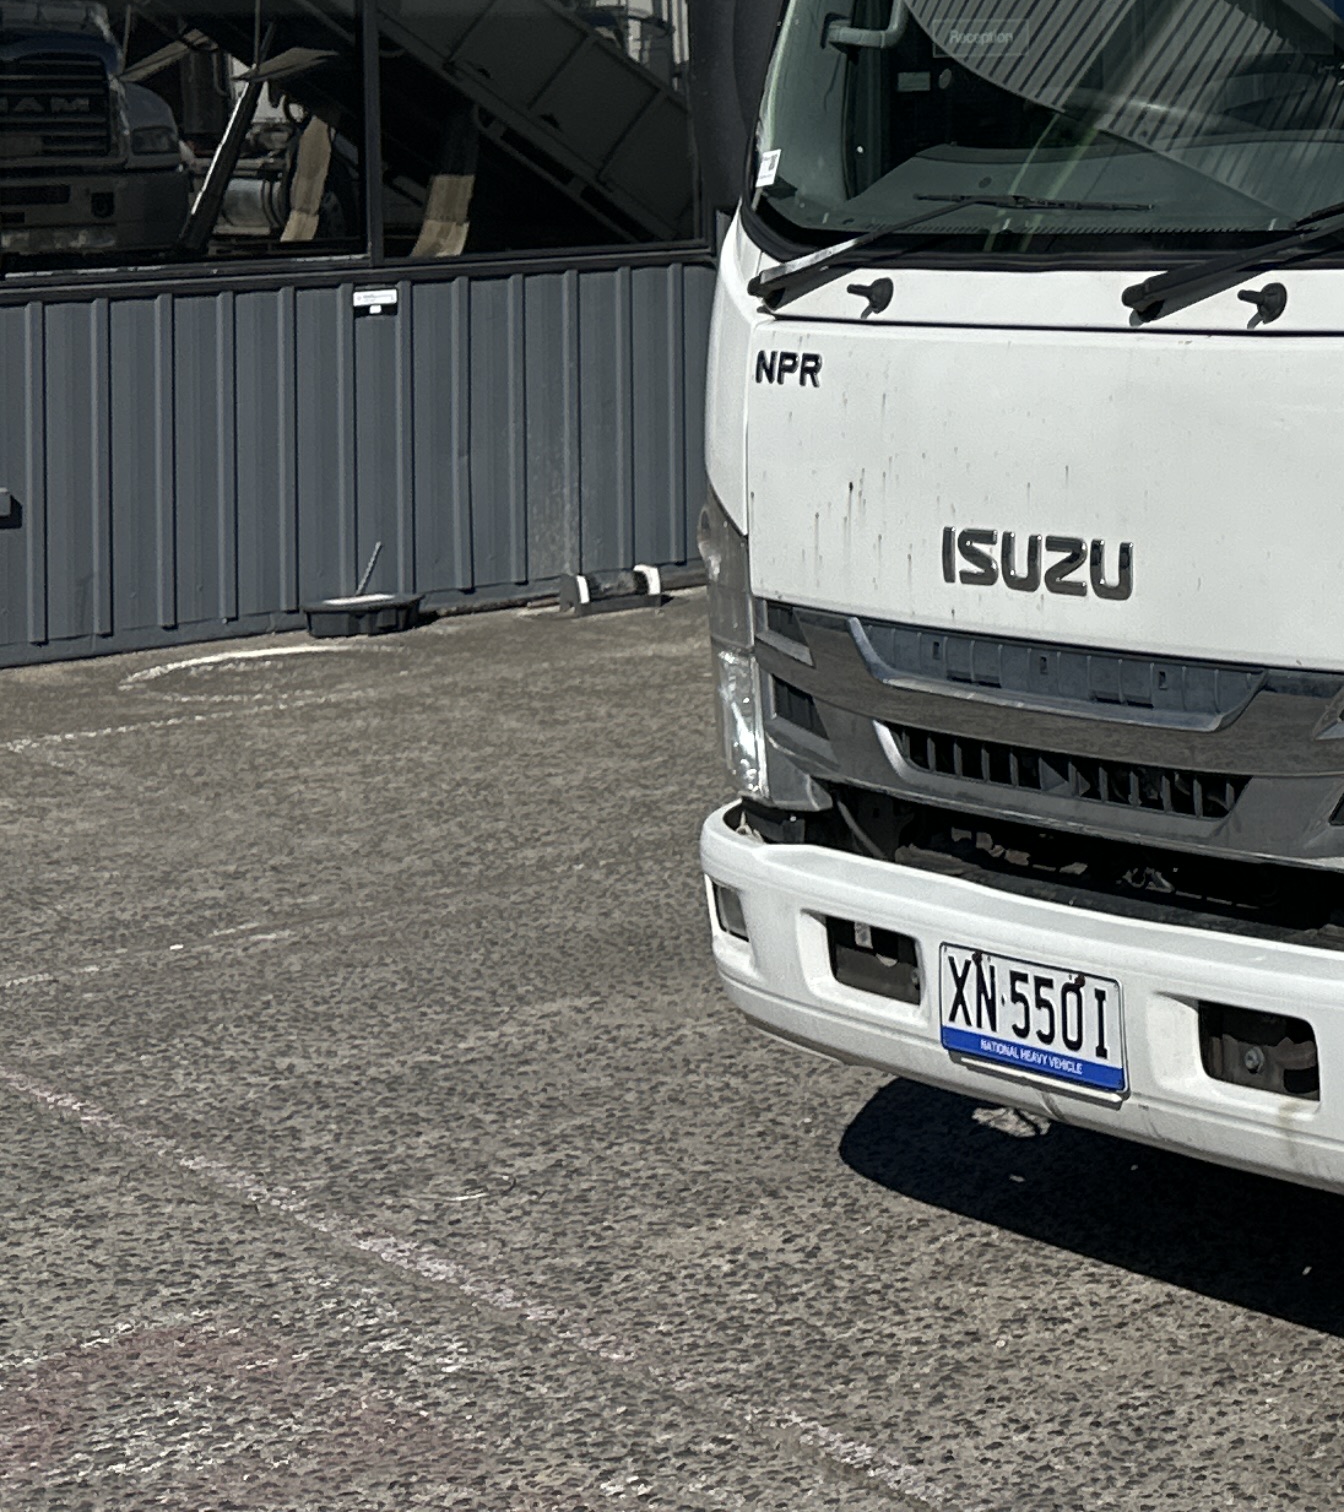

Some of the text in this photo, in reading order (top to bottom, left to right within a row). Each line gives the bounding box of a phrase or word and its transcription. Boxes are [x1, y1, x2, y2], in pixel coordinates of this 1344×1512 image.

[755, 349, 823, 388] NPR
[941, 525, 1134, 601] ISUZU
[980, 1039, 1083, 1075] NATIONAL HEAVY VEHICLE
